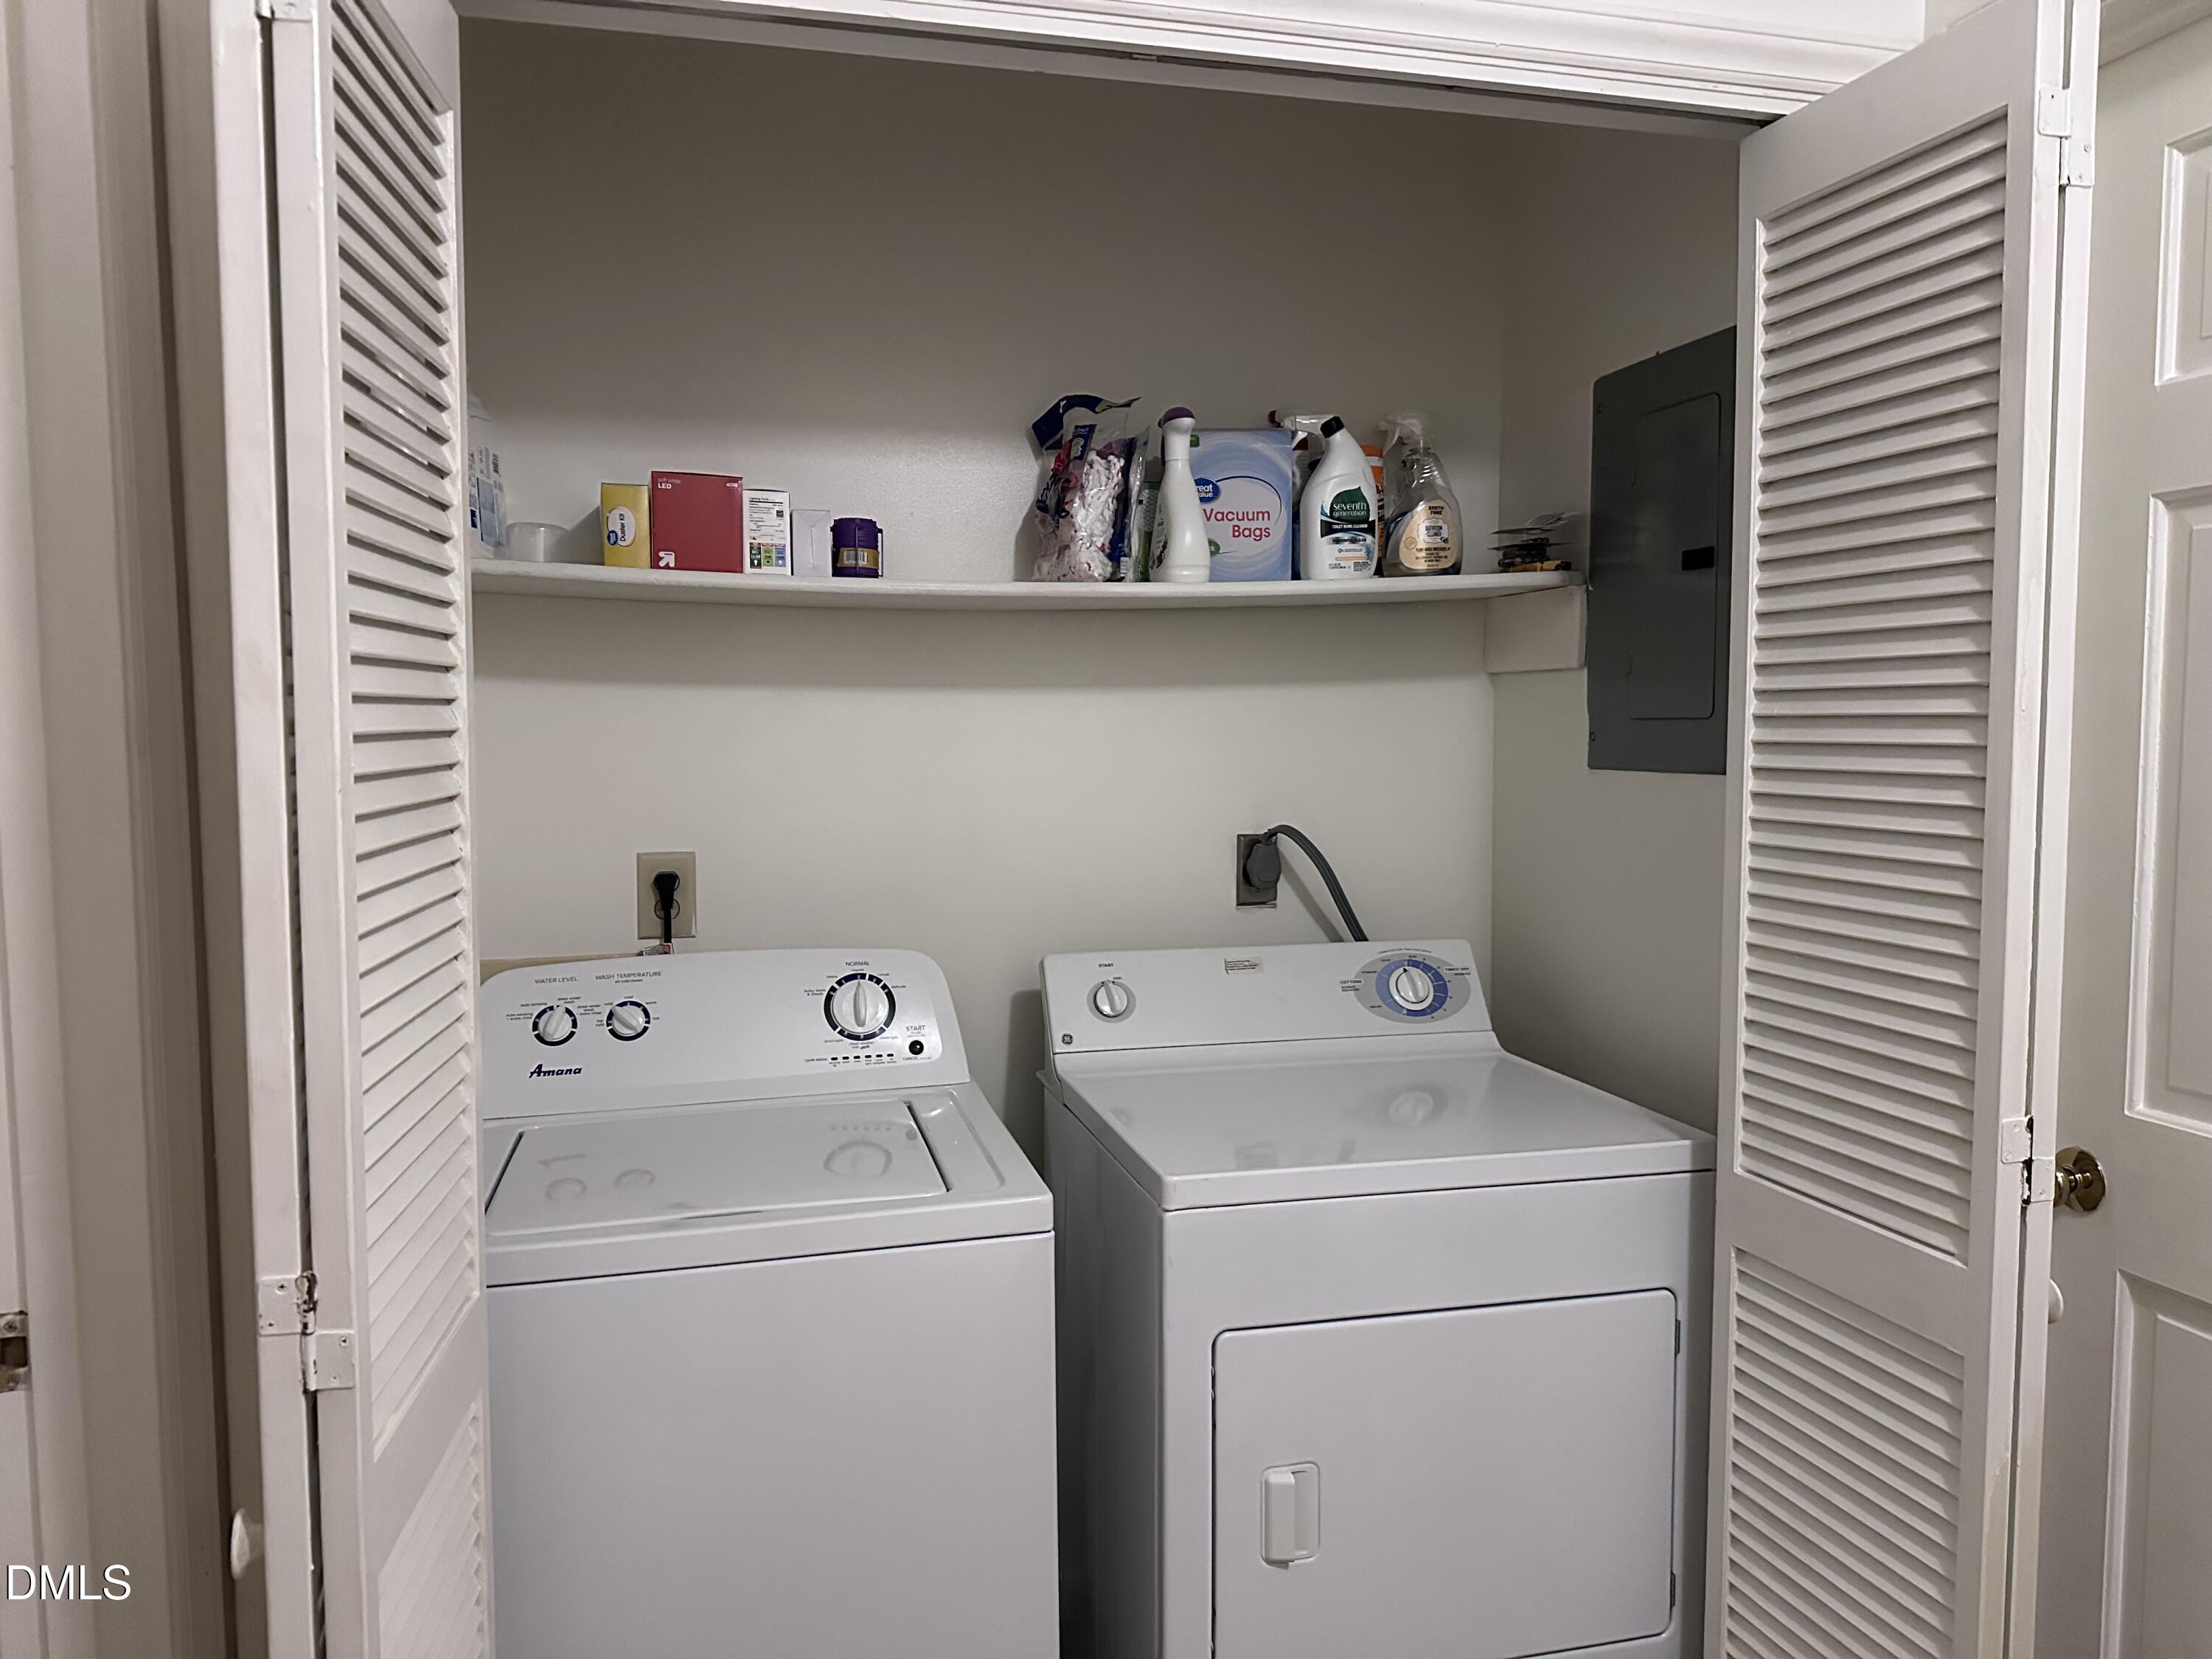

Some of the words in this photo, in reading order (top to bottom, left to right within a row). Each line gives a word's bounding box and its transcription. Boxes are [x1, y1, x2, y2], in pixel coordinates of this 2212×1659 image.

[1196, 484, 1213, 493] reat
[1333, 501, 1366, 510] seventh
[1203, 508, 1270, 521] Vacuum
[1232, 525, 1270, 541] Bags
[616, 971, 662, 979] TEMPERATURE
[529, 1063, 582, 1079] Amana
